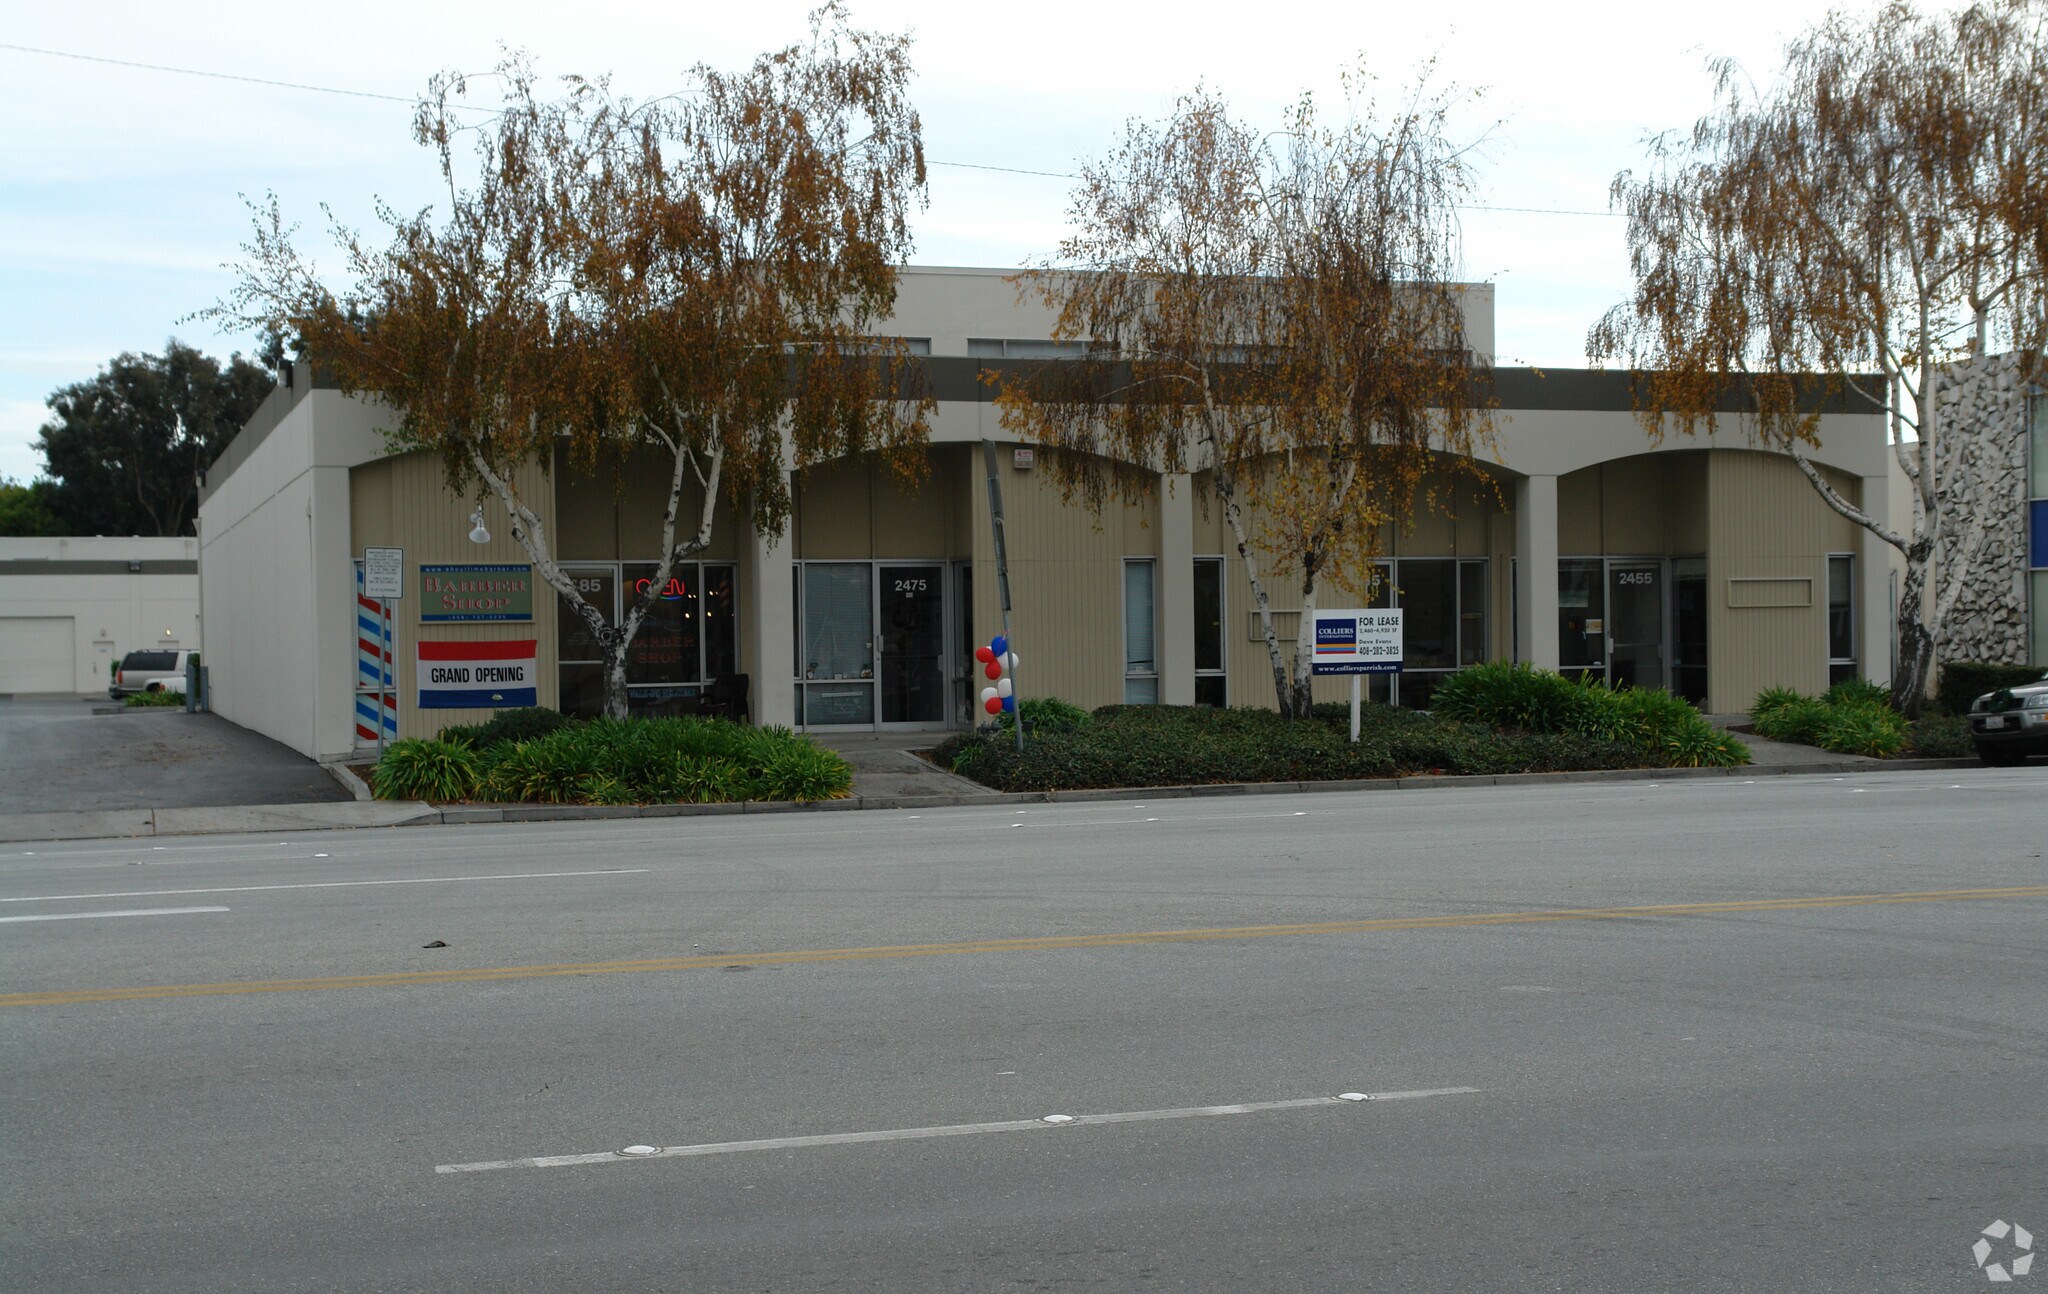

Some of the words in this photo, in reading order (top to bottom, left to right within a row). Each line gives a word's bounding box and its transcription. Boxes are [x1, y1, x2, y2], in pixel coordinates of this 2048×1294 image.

[425, 576, 526, 593] BARBER
[1619, 572, 1653, 585] 2455
[895, 579, 927, 592] 2475
[441, 594, 511, 610] SHOP
[1359, 617, 1374, 626] FOR
[1377, 616, 1399, 626] LEASE
[1318, 627, 1354, 635] COLLIERS
[431, 667, 470, 683] GRAND
[475, 666, 524, 683] OPENING
[1318, 664, 1397, 672] www.colliersparrish.com
